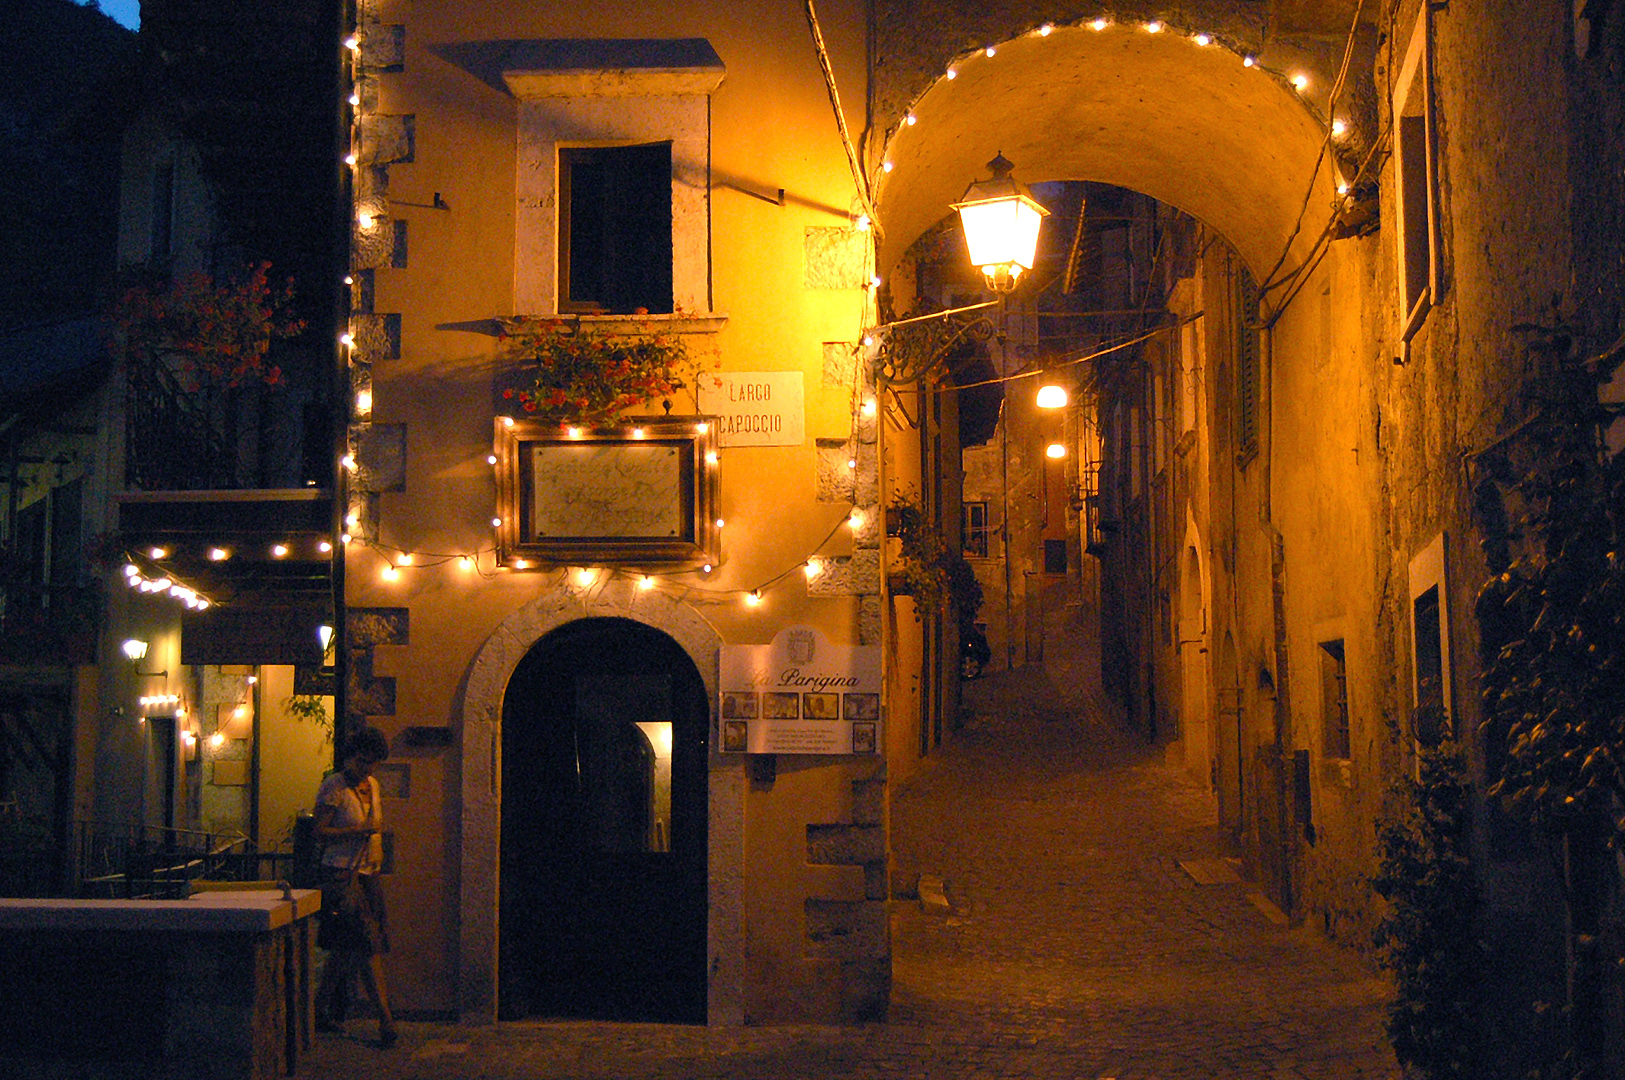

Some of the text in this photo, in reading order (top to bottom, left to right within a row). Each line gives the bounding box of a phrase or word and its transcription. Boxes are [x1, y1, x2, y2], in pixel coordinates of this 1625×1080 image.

[730, 383, 771, 402] LARGO
[719, 414, 781, 433] CAPOCCIO
[746, 668, 860, 692] La Parigina
